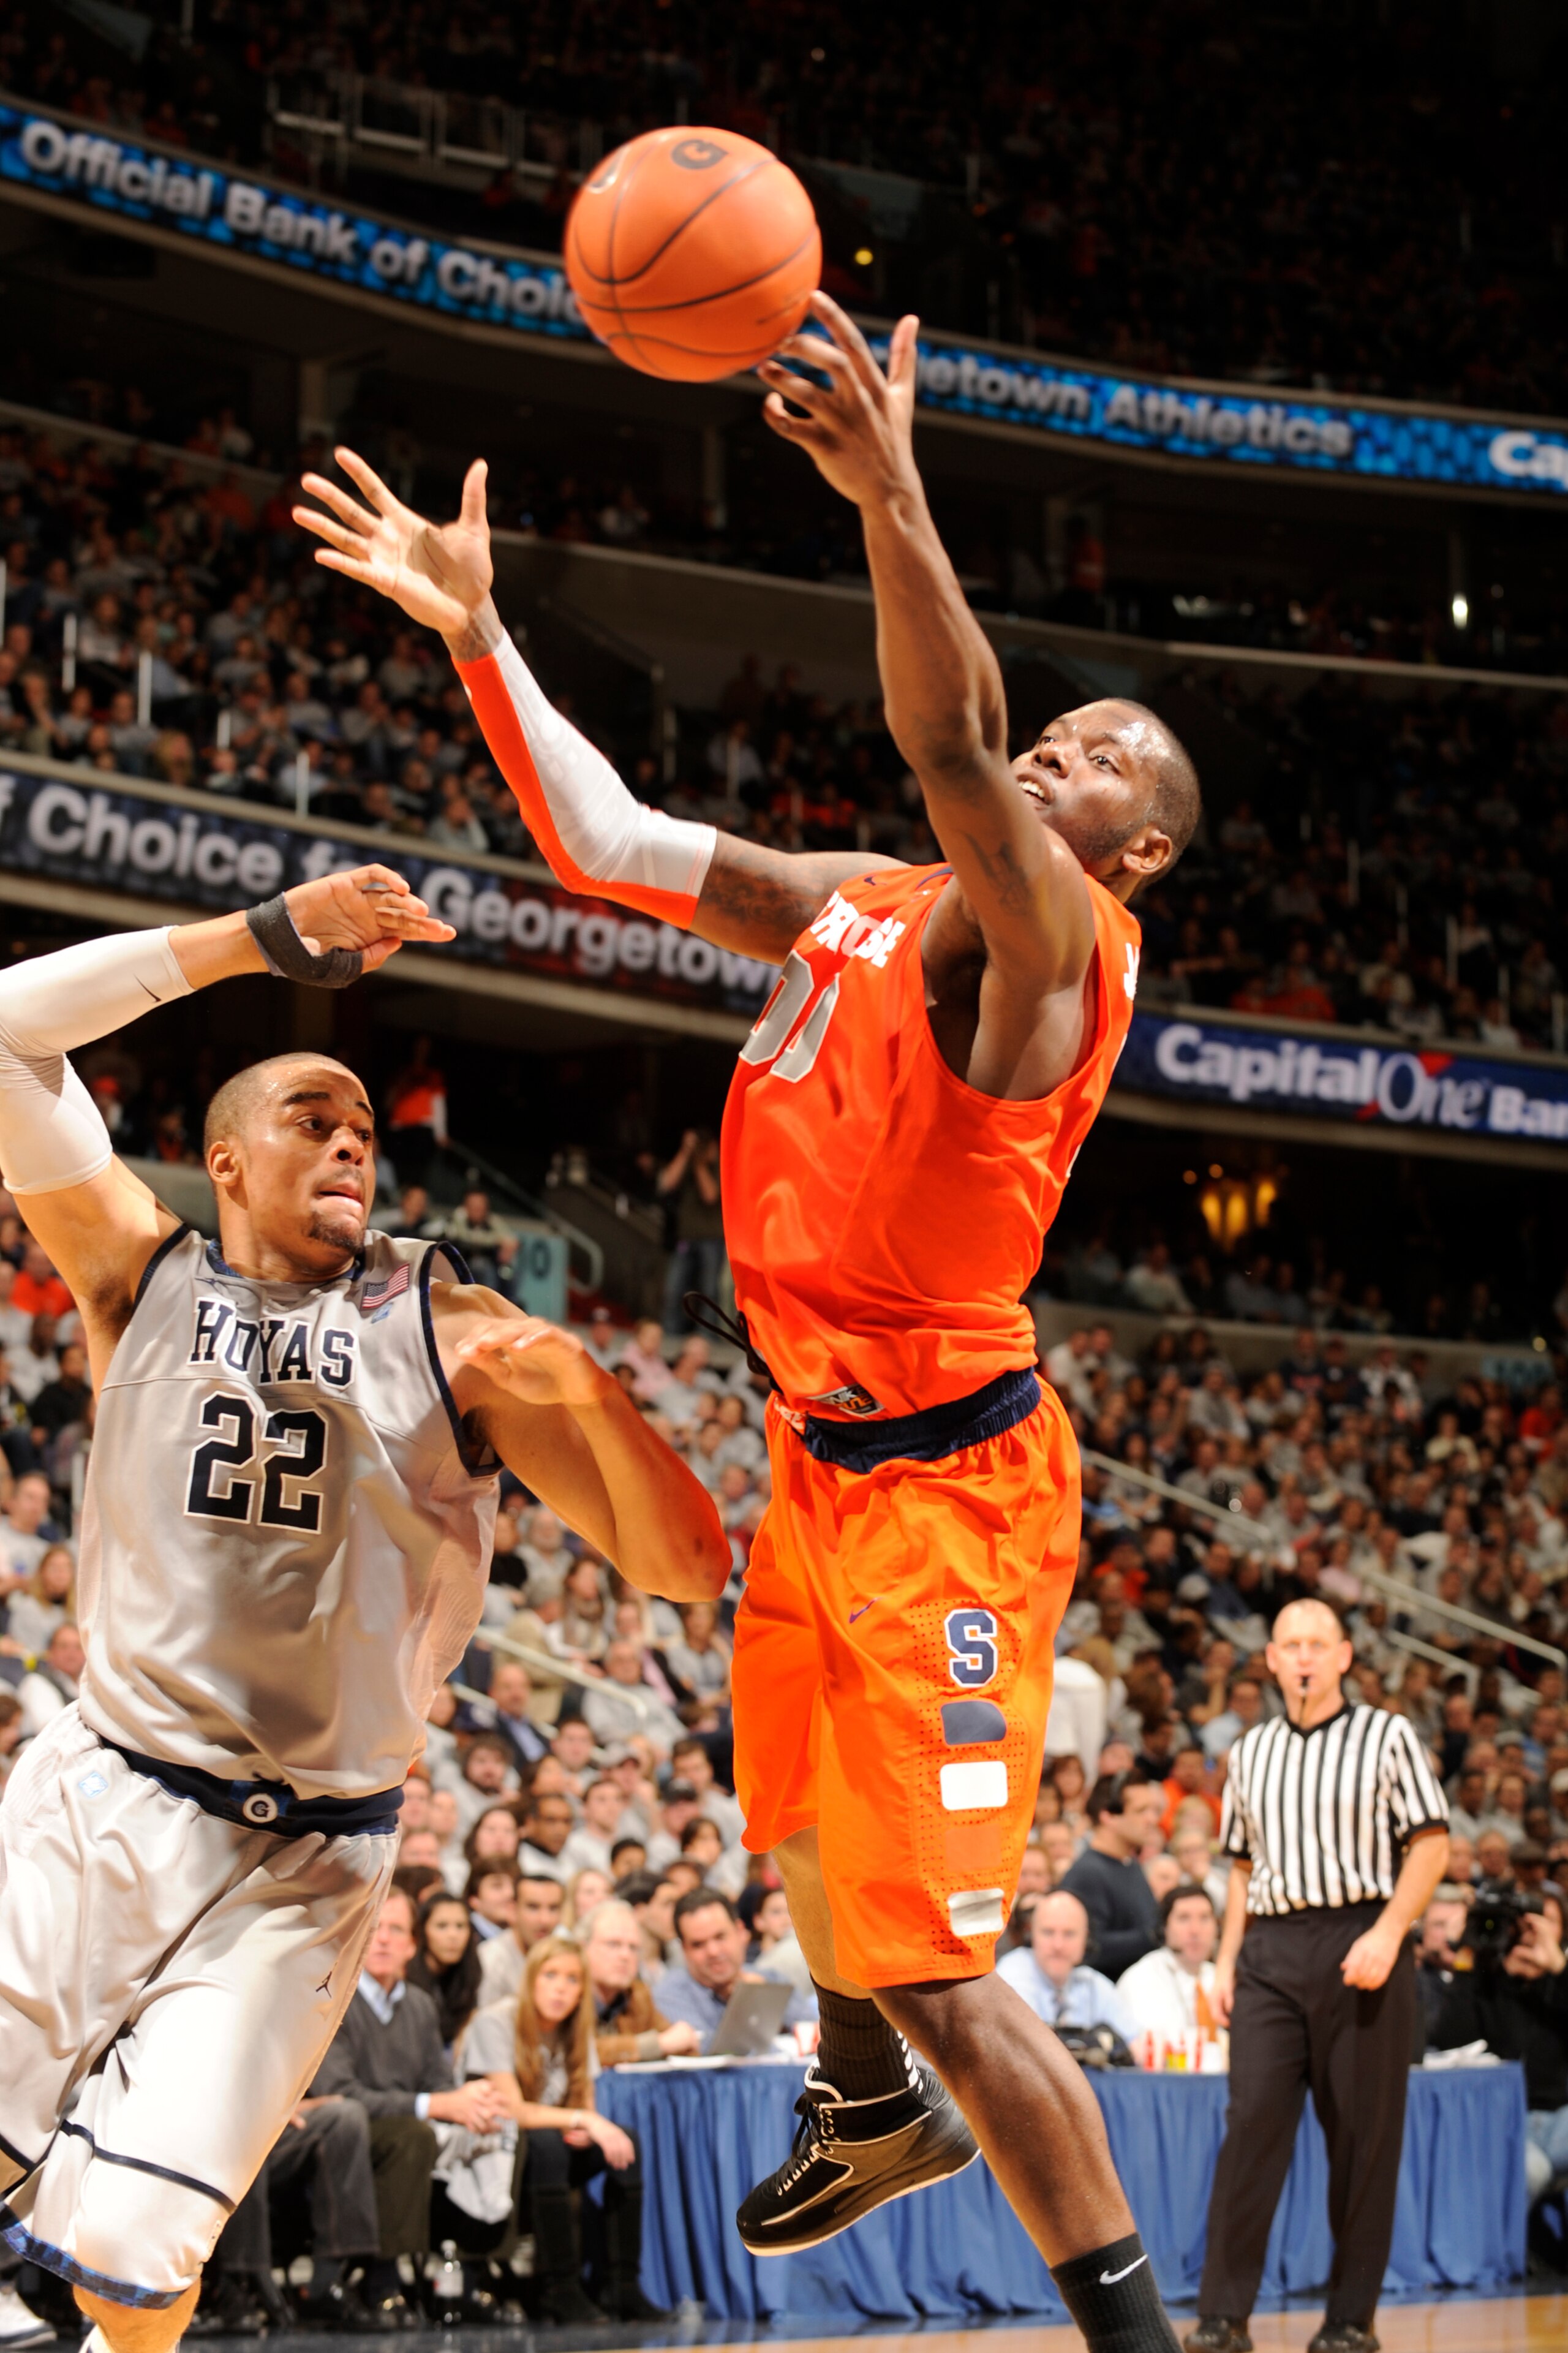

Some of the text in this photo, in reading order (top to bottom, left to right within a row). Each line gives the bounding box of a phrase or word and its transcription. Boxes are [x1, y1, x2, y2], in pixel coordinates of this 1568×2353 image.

[21, 121, 212, 218] Official
[225, 183, 358, 262] Bank
[369, 240, 428, 279] of
[1102, 382, 1351, 457] Athletics
[1488, 430, 1568, 490] Ca
[28, 784, 283, 894] Choice
[186, 1296, 358, 1391] HOYAS
[184, 1390, 328, 1535] 22
[944, 1607, 998, 1688] S
[251, 1800, 270, 1818] G
